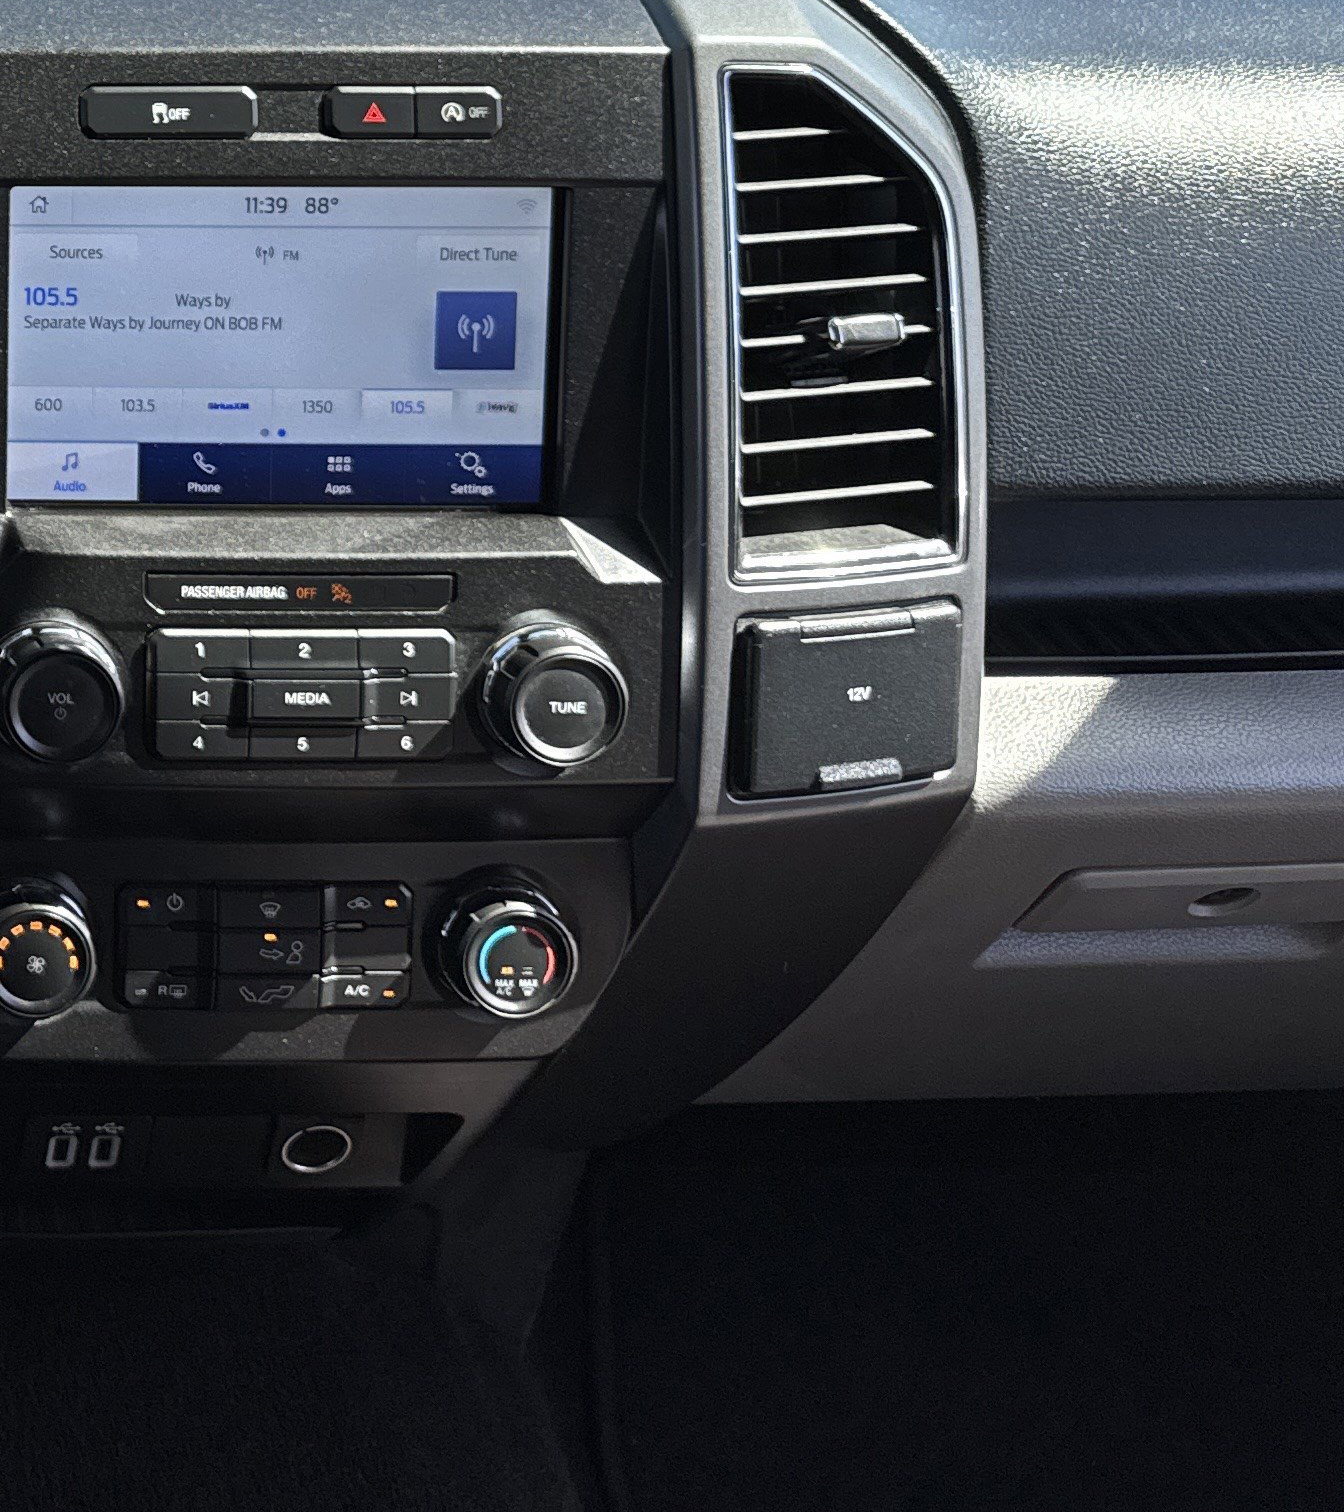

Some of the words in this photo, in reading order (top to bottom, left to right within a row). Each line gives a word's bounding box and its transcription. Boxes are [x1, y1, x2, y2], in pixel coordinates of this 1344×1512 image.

[168, 108, 190, 120] OFF
[468, 107, 489, 119] OFF
[244, 196, 288, 214] 11:39
[304, 196, 339, 214] 88°
[49, 245, 104, 260] Sources
[283, 250, 300, 261] FM
[439, 247, 480, 262] Direct
[483, 247, 518, 262] Tune
[24, 286, 79, 307] 105.5
[175, 293, 212, 310] Ways
[214, 292, 231, 310] by
[24, 315, 86, 332] Separate
[89, 315, 126, 331] Ways
[128, 314, 145, 331] by
[148, 316, 201, 332] Journey
[203, 316, 225, 330] ON
[228, 317, 258, 331] BOB
[262, 317, 282, 331] FM
[34, 398, 63, 413] 600
[120, 399, 156, 413] 103.5
[302, 400, 333, 414] 1350
[390, 400, 425, 414] 105.5
[53, 481, 87, 493] Audio
[187, 482, 221, 494] Phone
[324, 483, 352, 495] Apps
[450, 483, 494, 497] Settings
[181, 585, 245, 600] PASSENGER
[246, 585, 288, 600] AIRBAG
[296, 587, 318, 600] OFF
[194, 642, 206, 658] 1
[298, 642, 312, 659] 2
[403, 642, 416, 658] 3
[47, 692, 74, 705] VOL
[285, 692, 331, 706] MEDIA
[847, 686, 872, 702] 12V
[549, 701, 588, 715] TUNE
[193, 735, 205, 751] 4
[297, 737, 310, 751] 5
[400, 735, 413, 750] 6
[344, 984, 370, 997] A/C
